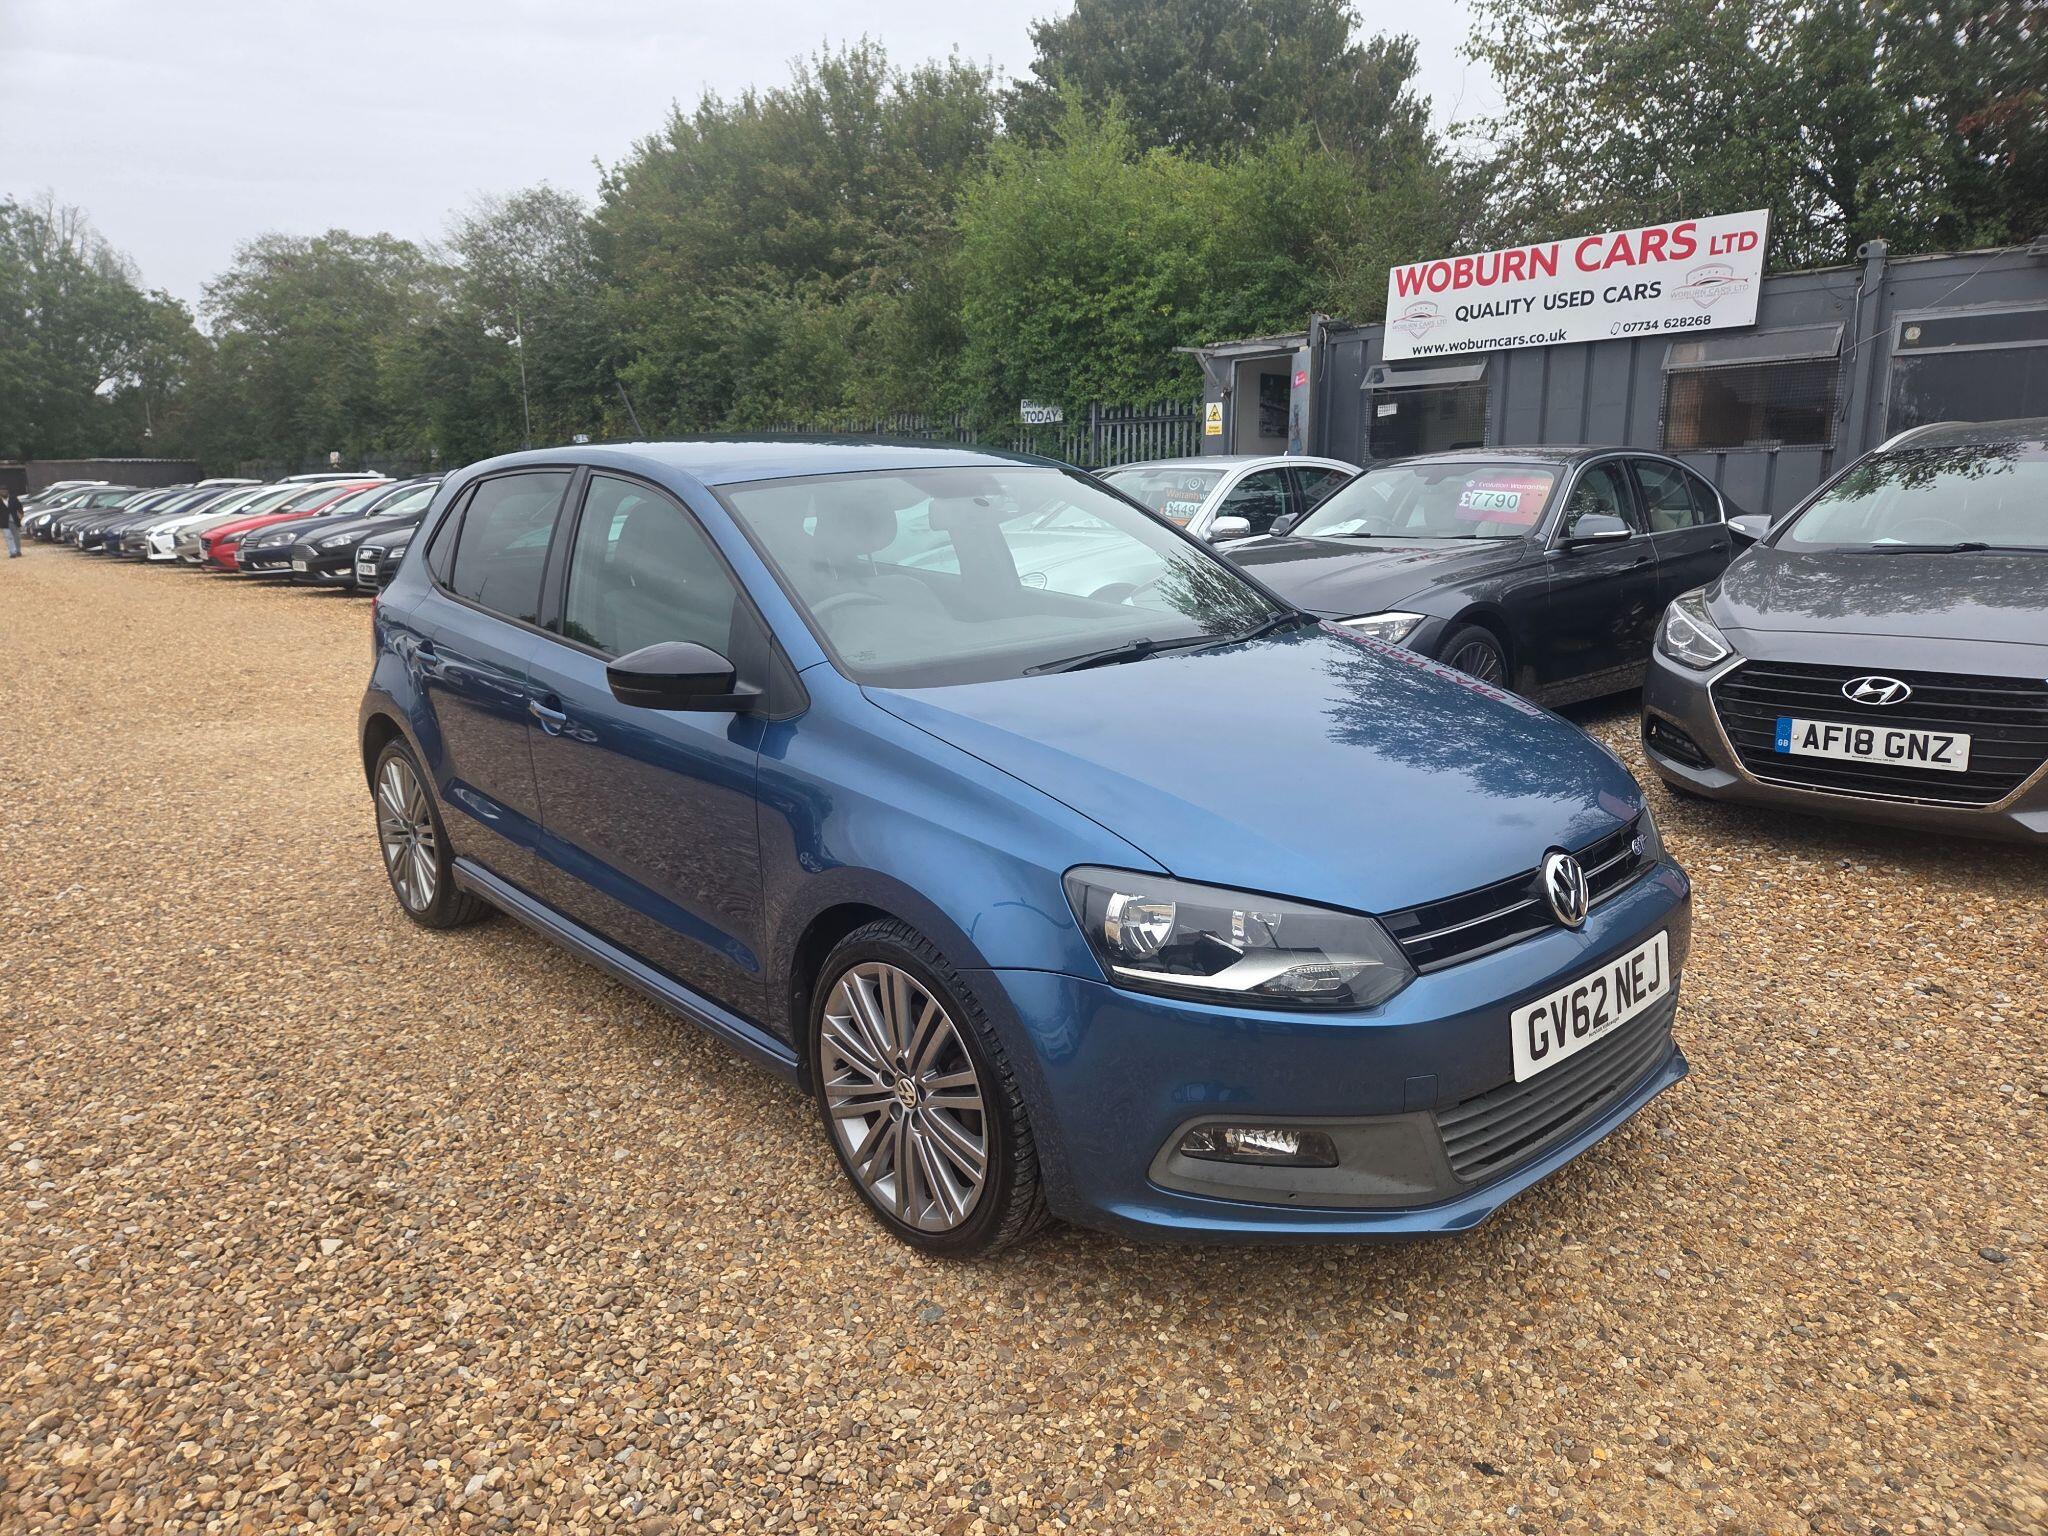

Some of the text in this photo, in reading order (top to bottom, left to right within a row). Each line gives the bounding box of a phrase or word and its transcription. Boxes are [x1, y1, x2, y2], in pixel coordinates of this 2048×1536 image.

[1396, 222, 1759, 297] WOBURN CARS LTD
[1455, 281, 1662, 322] QUALITY USED CARS
[1622, 315, 1712, 333] 07734 628268
[1412, 328, 1568, 356] www.woburncars.co.uk
[1024, 409, 1060, 423] TODAY
[1777, 738, 1789, 747] GB
[1802, 724, 1954, 764] AF18 GNZ
[1528, 942, 1661, 1061] GV62 NEJ
